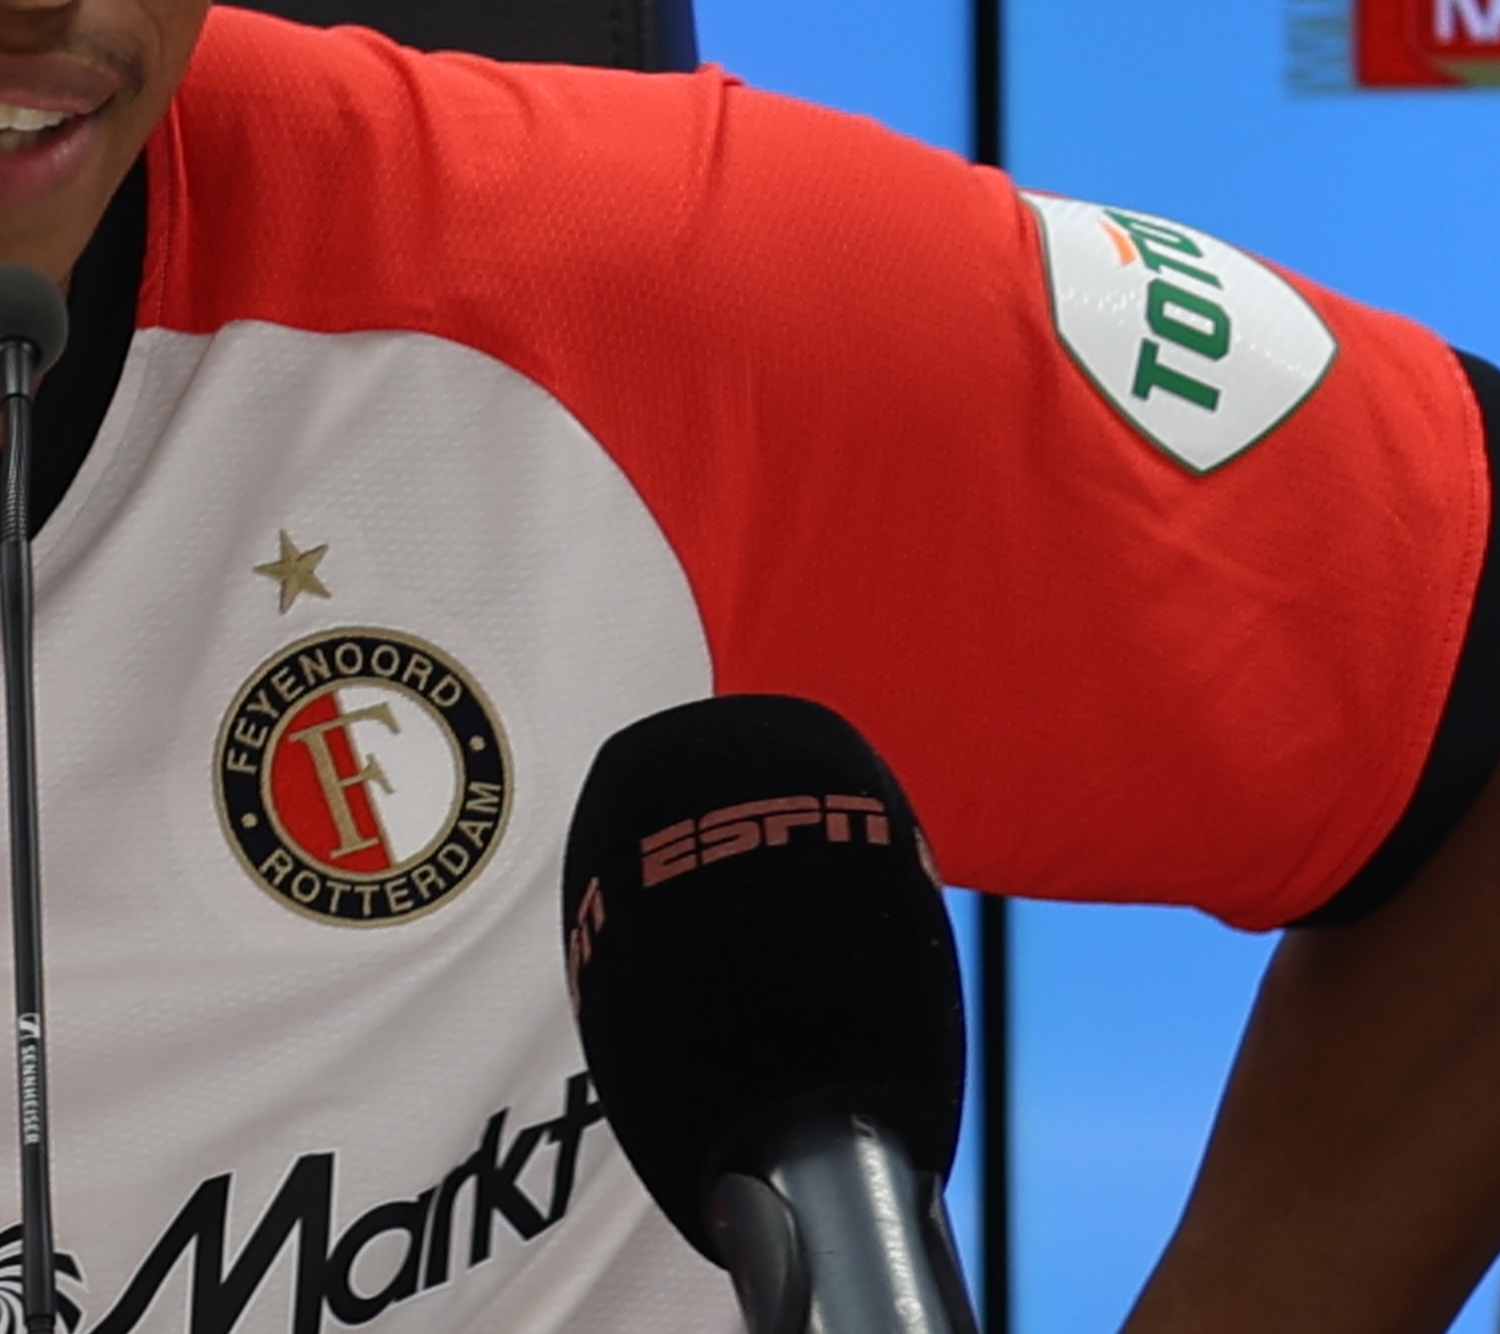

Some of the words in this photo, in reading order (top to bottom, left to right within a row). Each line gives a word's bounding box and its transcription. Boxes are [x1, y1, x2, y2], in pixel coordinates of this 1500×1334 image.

[226, 642, 462, 775] FEYENOORD
[259, 781, 502, 916] ROTTERDAM
[640, 794, 890, 888] ESPN
